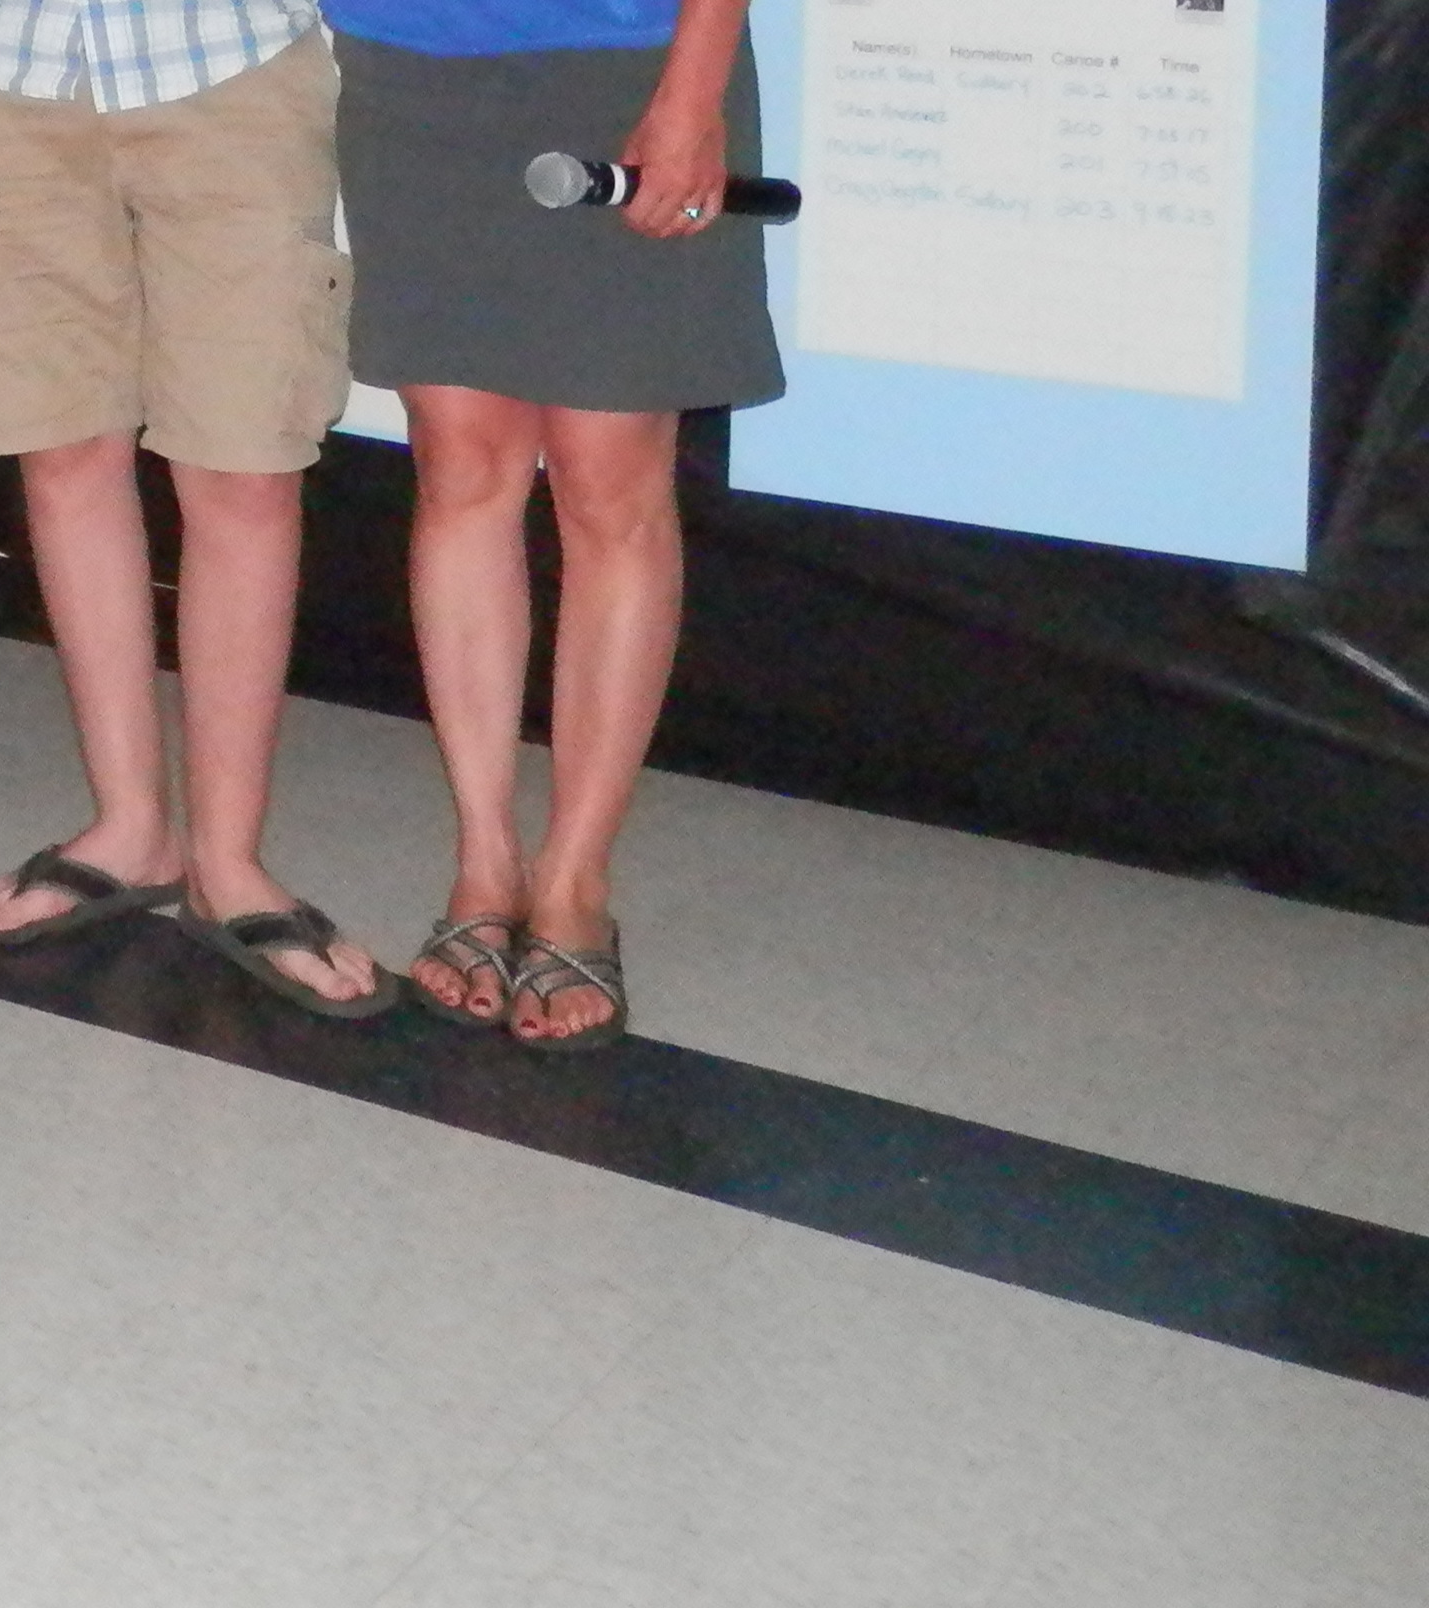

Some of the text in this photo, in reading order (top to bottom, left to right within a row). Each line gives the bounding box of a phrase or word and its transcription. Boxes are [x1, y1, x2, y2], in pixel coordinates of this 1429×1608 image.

[852, 40, 917, 57] Name(s)
[949, 45, 1034, 65] Hometown
[1050, 51, 1105, 69] Canoe
[1158, 57, 1200, 74] Time
